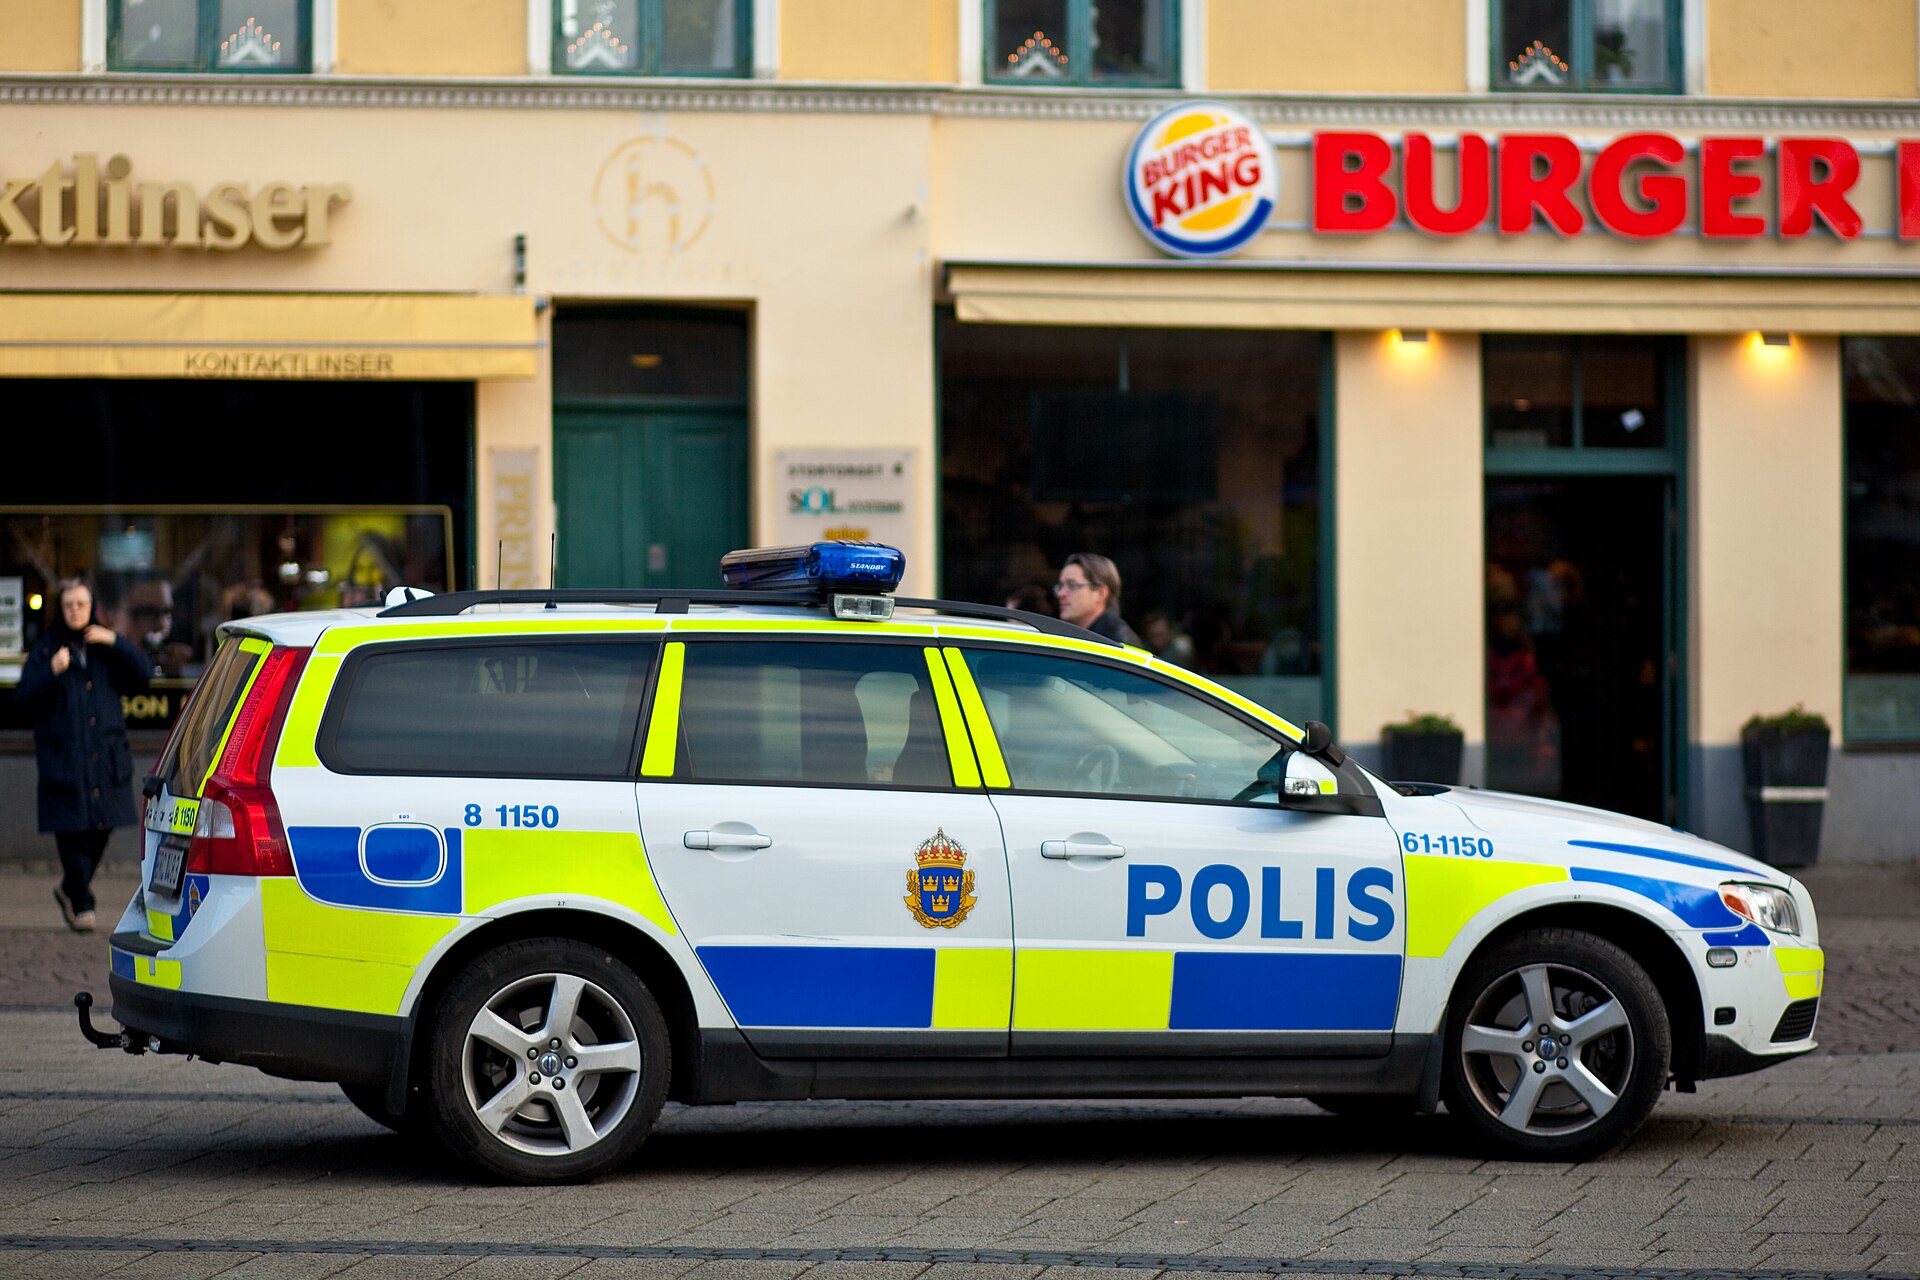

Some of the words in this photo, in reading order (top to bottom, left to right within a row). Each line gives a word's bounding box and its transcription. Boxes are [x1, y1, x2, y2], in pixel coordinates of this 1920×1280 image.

[1143, 127, 1252, 188] BURGER
[1153, 153, 1261, 228] KING
[1312, 131, 1864, 240] BURGER
[185, 351, 394, 374] KONTAKTLINSER
[849, 562, 887, 571] STANDBY
[173, 806, 180, 826] 8
[180, 807, 196, 827] 1150
[463, 803, 482, 827] 8
[495, 804, 560, 828] 1150
[1402, 831, 1495, 858] 61-1150
[1126, 863, 1395, 941] POLIS
